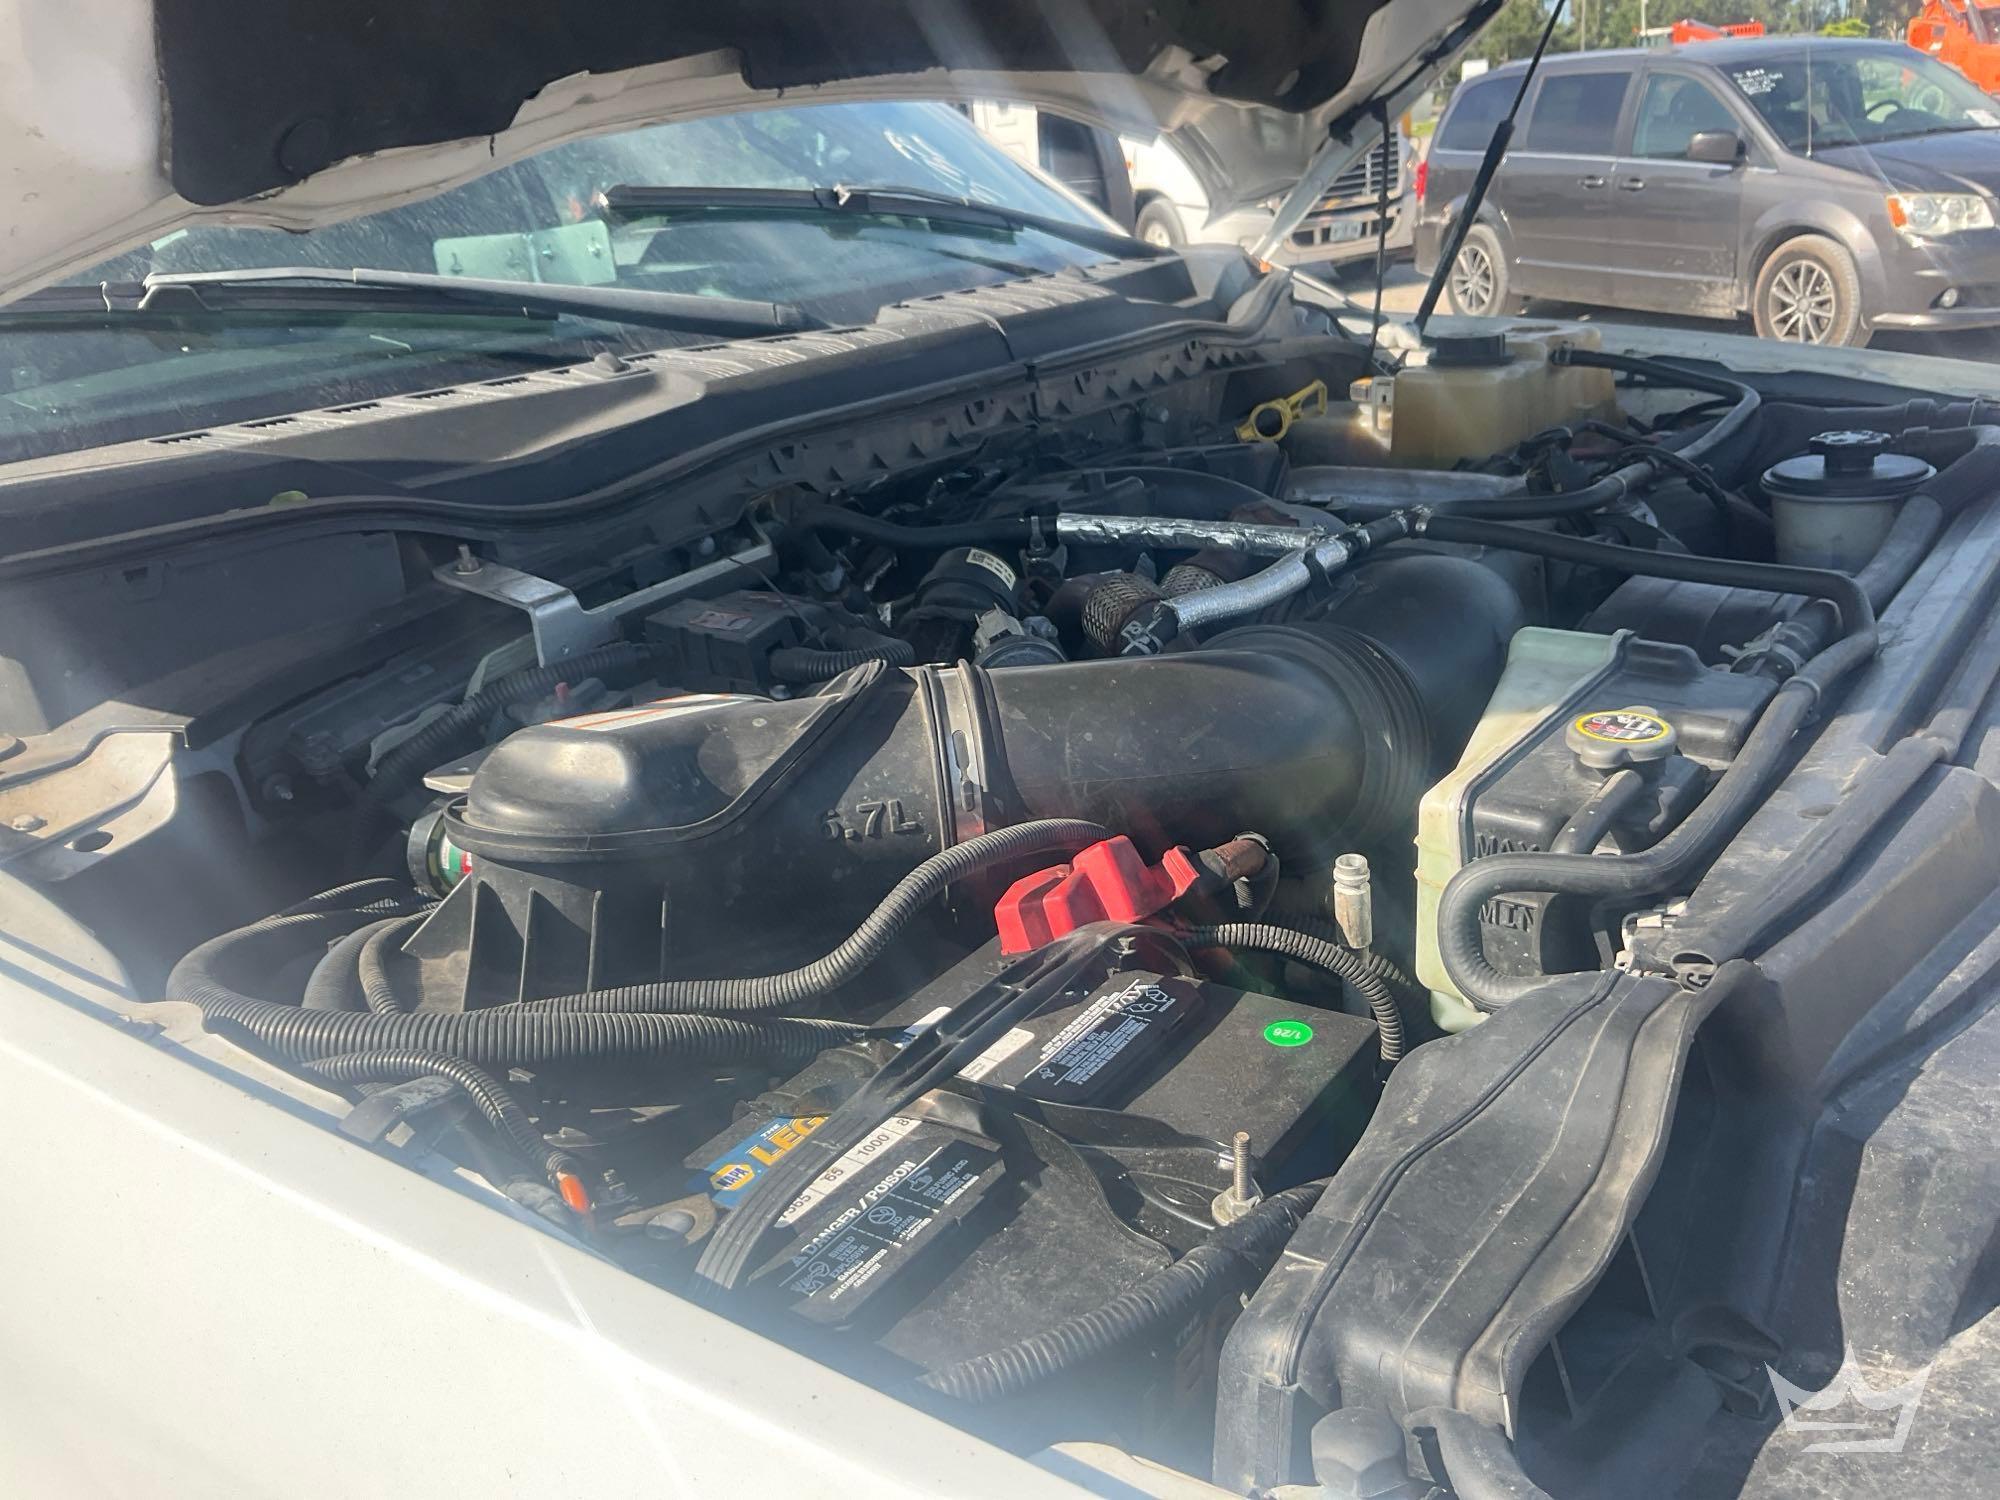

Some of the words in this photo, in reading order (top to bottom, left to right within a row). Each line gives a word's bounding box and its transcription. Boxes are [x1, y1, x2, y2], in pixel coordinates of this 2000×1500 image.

[1478, 899, 1537, 933] MIN
[760, 1123, 780, 1138] THE
[857, 1133, 891, 1156] 1000
[716, 1166, 751, 1189] NAPA
[801, 1207, 861, 1255] DANGER
[865, 1160, 917, 1201] POISON
